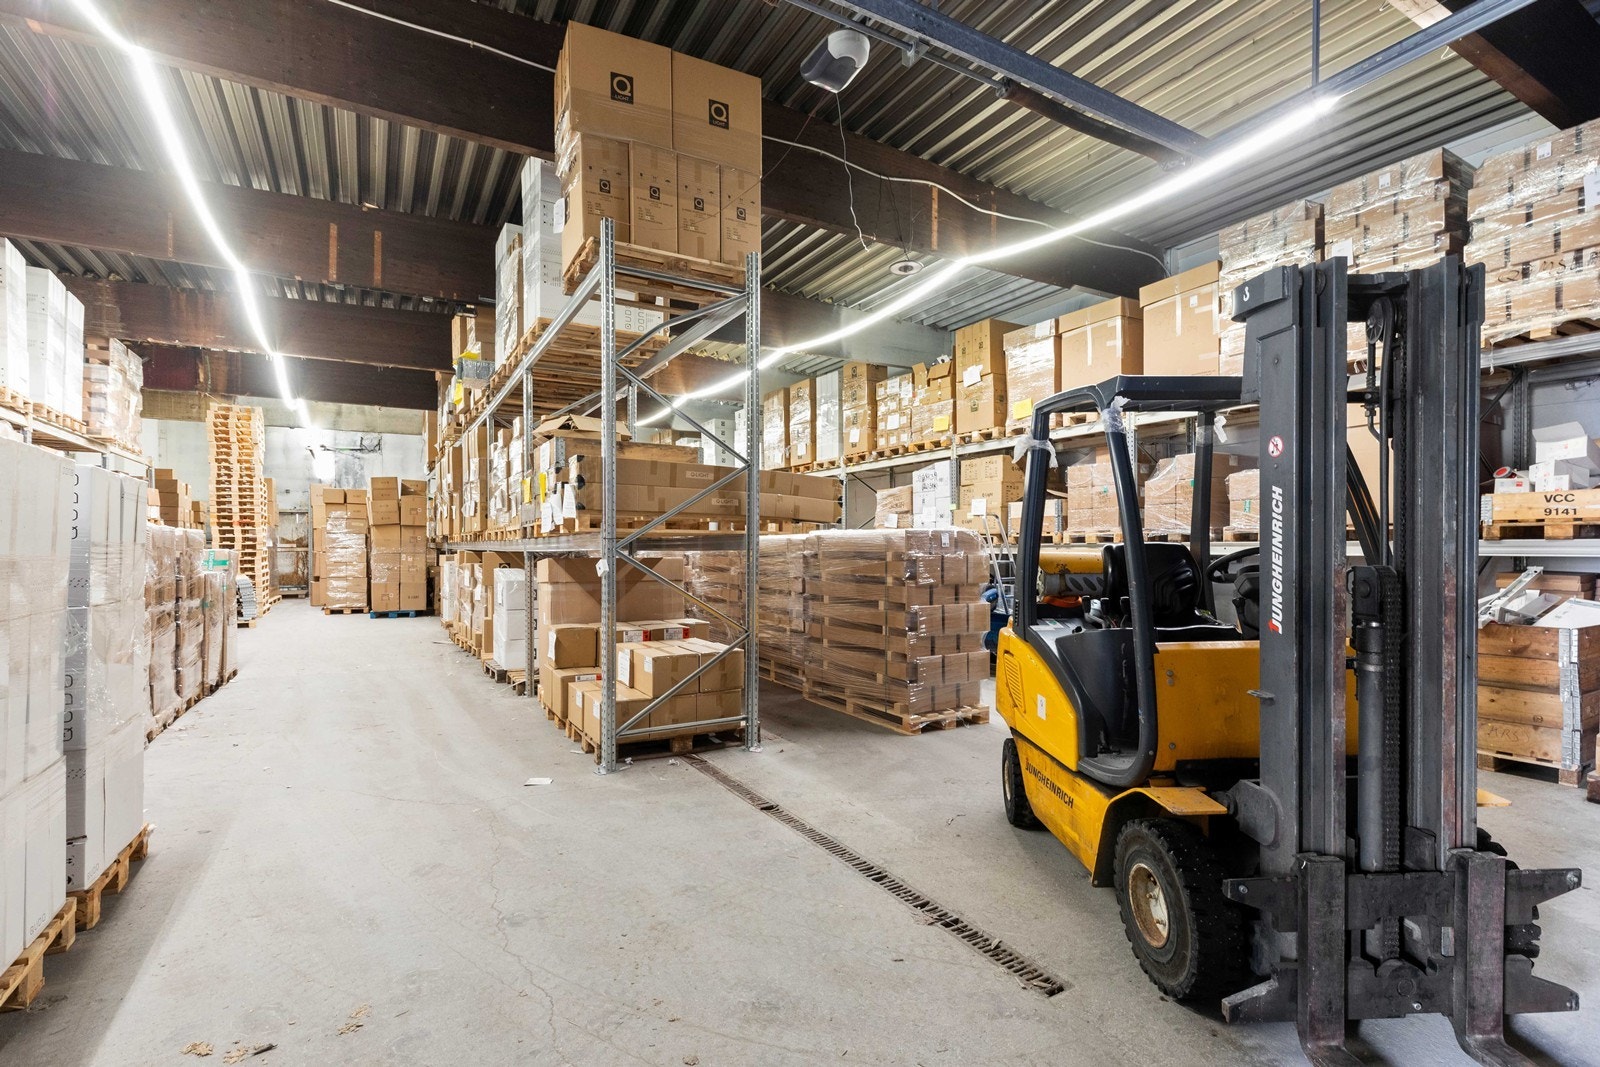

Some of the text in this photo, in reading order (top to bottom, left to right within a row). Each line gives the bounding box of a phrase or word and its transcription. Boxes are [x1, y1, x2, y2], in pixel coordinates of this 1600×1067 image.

[613, 76, 631, 97] Q
[711, 103, 728, 122] Q
[1543, 493, 1576, 503] VCC
[1543, 507, 1577, 516] 9141
[1268, 485, 1283, 635] JUNGHEINRICH
[1025, 761, 1075, 808] JUNGHEINRICH
